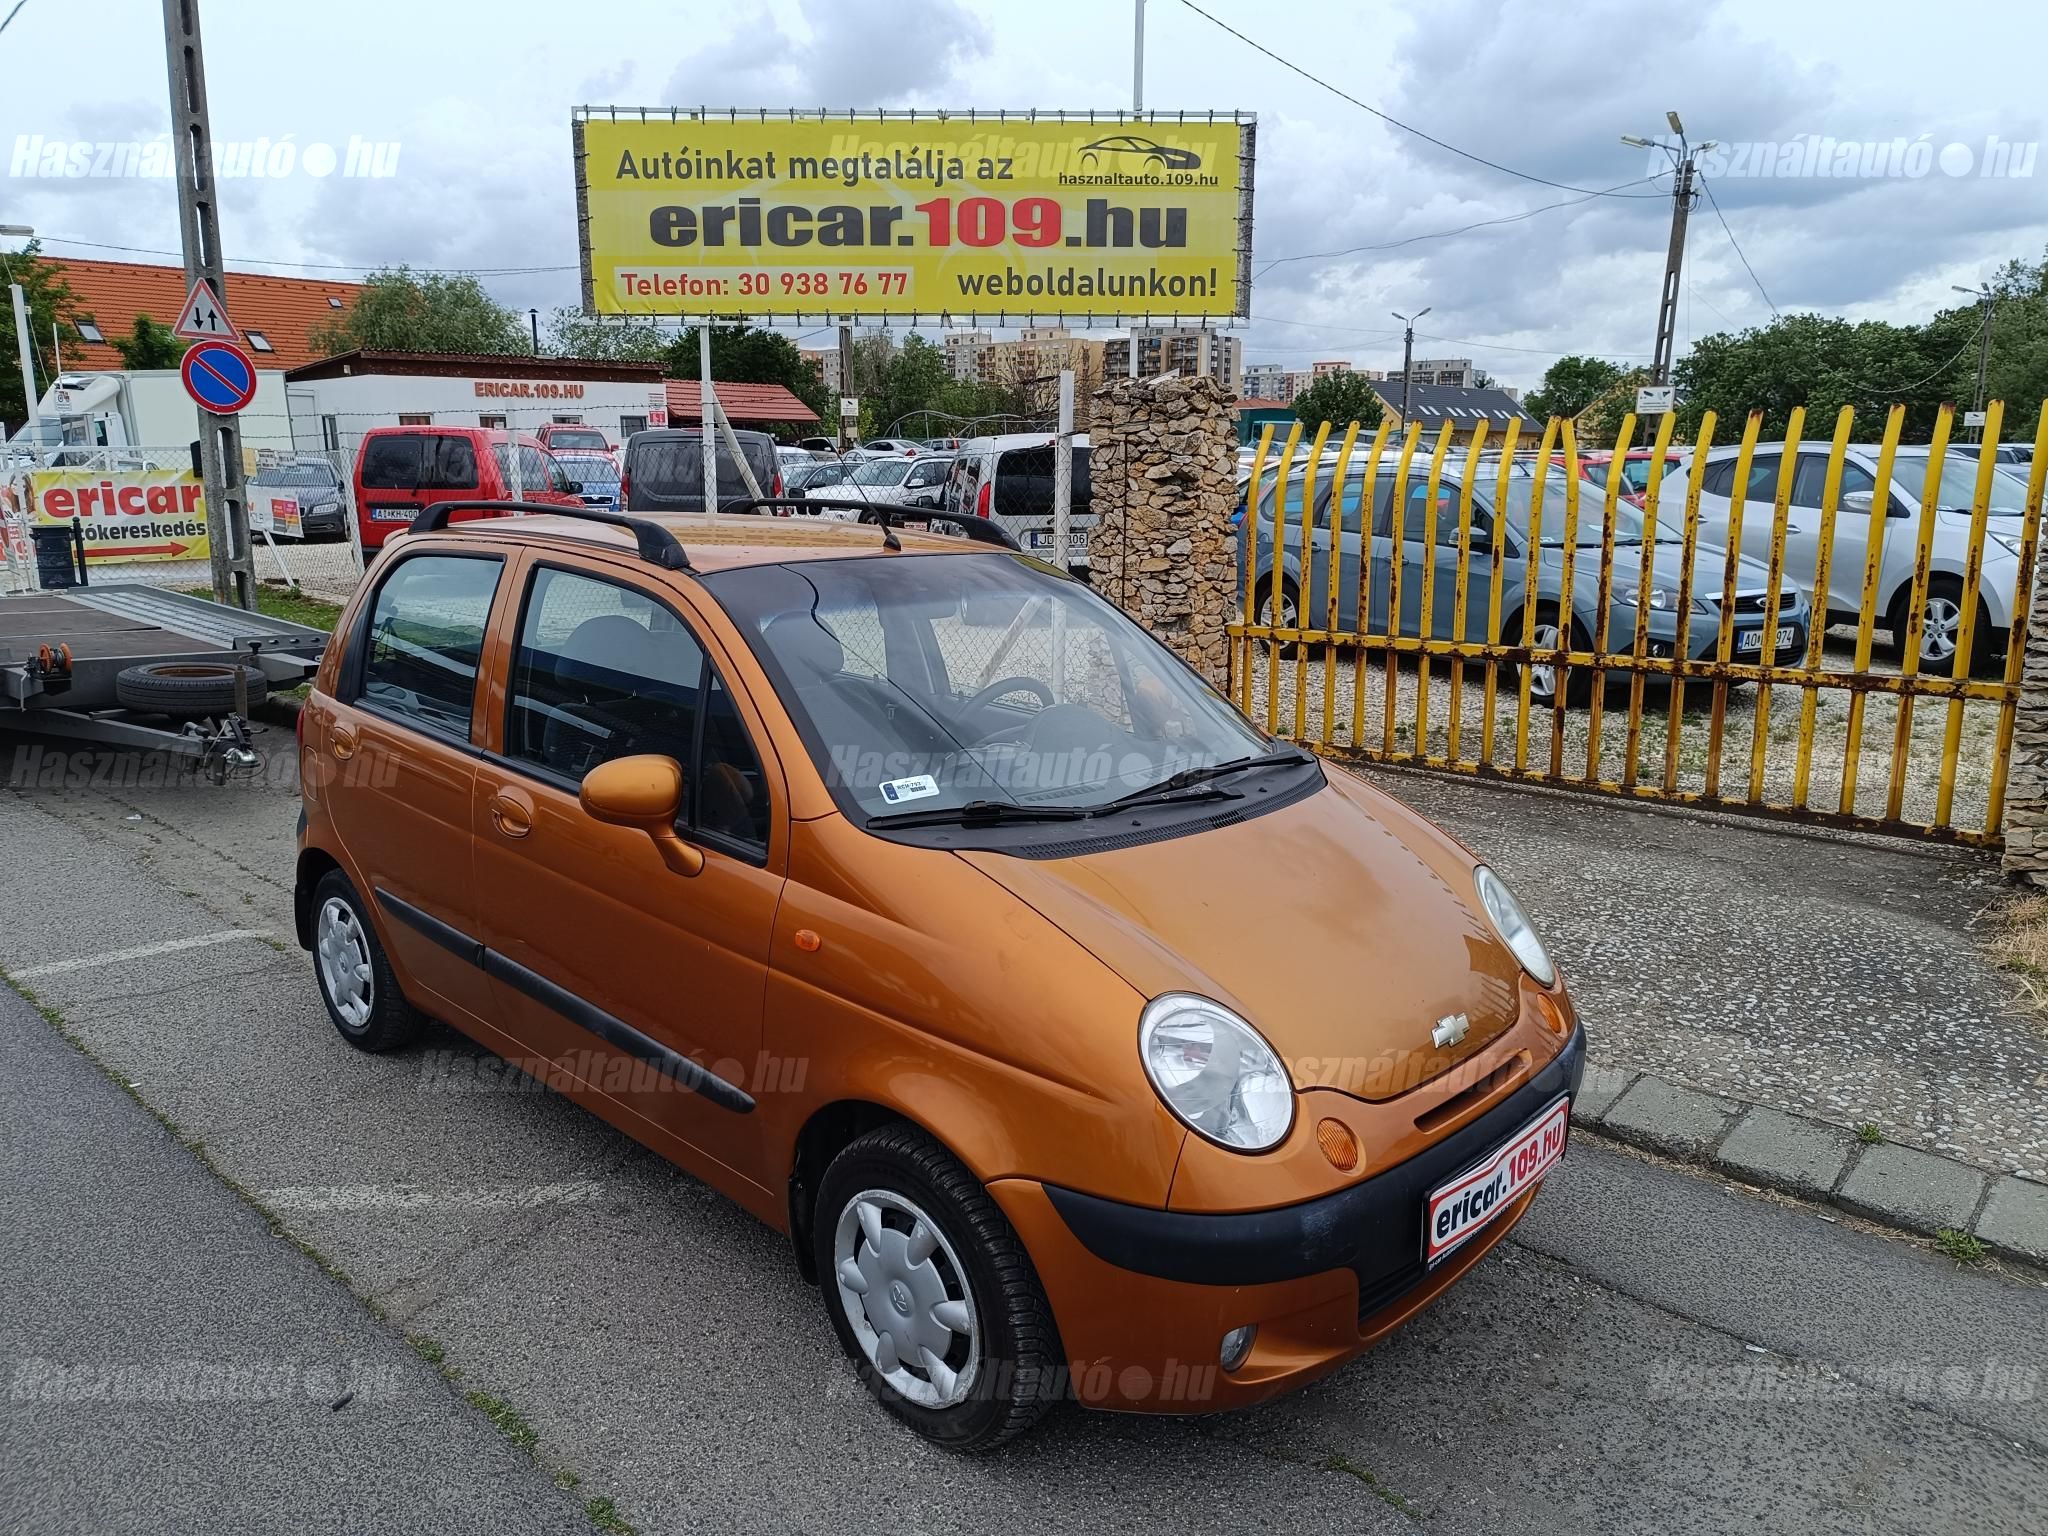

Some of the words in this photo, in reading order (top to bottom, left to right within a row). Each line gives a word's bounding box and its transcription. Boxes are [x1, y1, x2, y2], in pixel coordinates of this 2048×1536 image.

[616, 147, 776, 180] Autóinkat
[788, 146, 965, 187] megtalálja
[977, 155, 1014, 180] az
[1058, 172, 1219, 185] hasznaltauto.109.hu
[649, 197, 1187, 248] ericar.109.hu
[620, 273, 729, 296] Telefon:
[738, 273, 770, 296] 30
[780, 272, 829, 296] 938
[839, 272, 867, 295] 76
[877, 272, 908, 295] 77
[957, 266, 1217, 297] weboldalunkon!
[474, 381, 584, 399] ERICAR.109.HU
[43, 481, 202, 518] ericar
